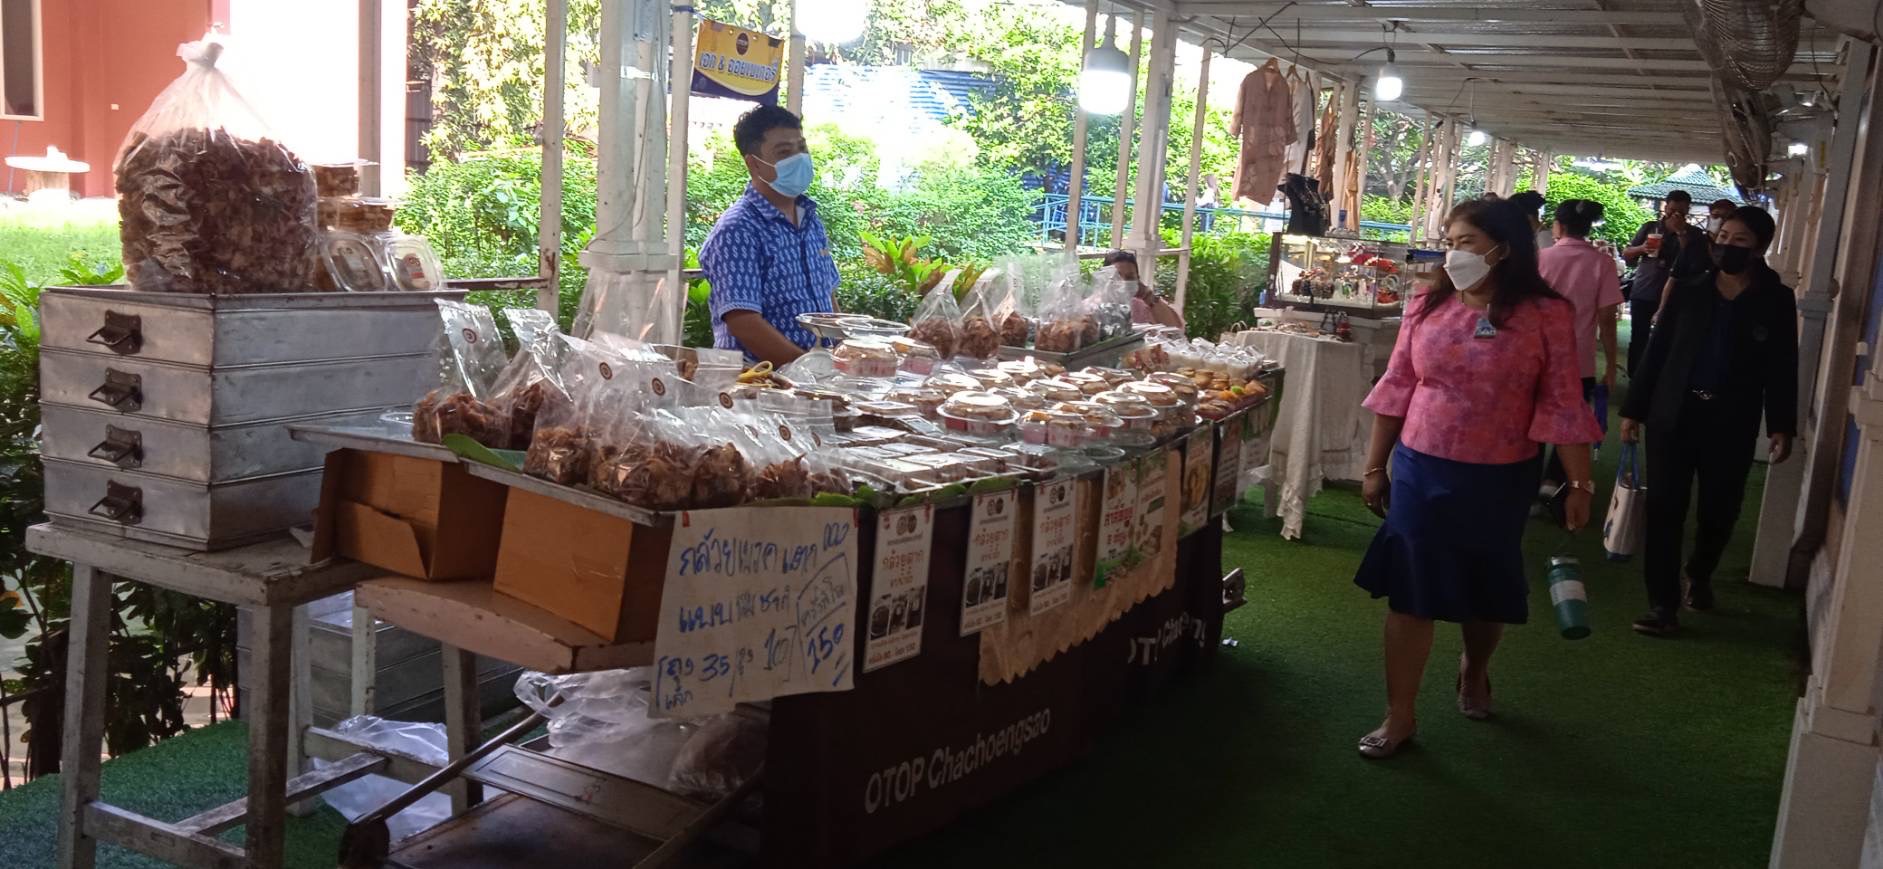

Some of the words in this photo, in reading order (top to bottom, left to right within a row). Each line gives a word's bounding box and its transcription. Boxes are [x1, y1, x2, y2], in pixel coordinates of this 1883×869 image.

[718, 56, 725, 71] &
[698, 653, 731, 682] 35
[807, 622, 845, 675] 150
[864, 755, 926, 814] OTOP
[927, 706, 1052, 790] Chachoengsao
